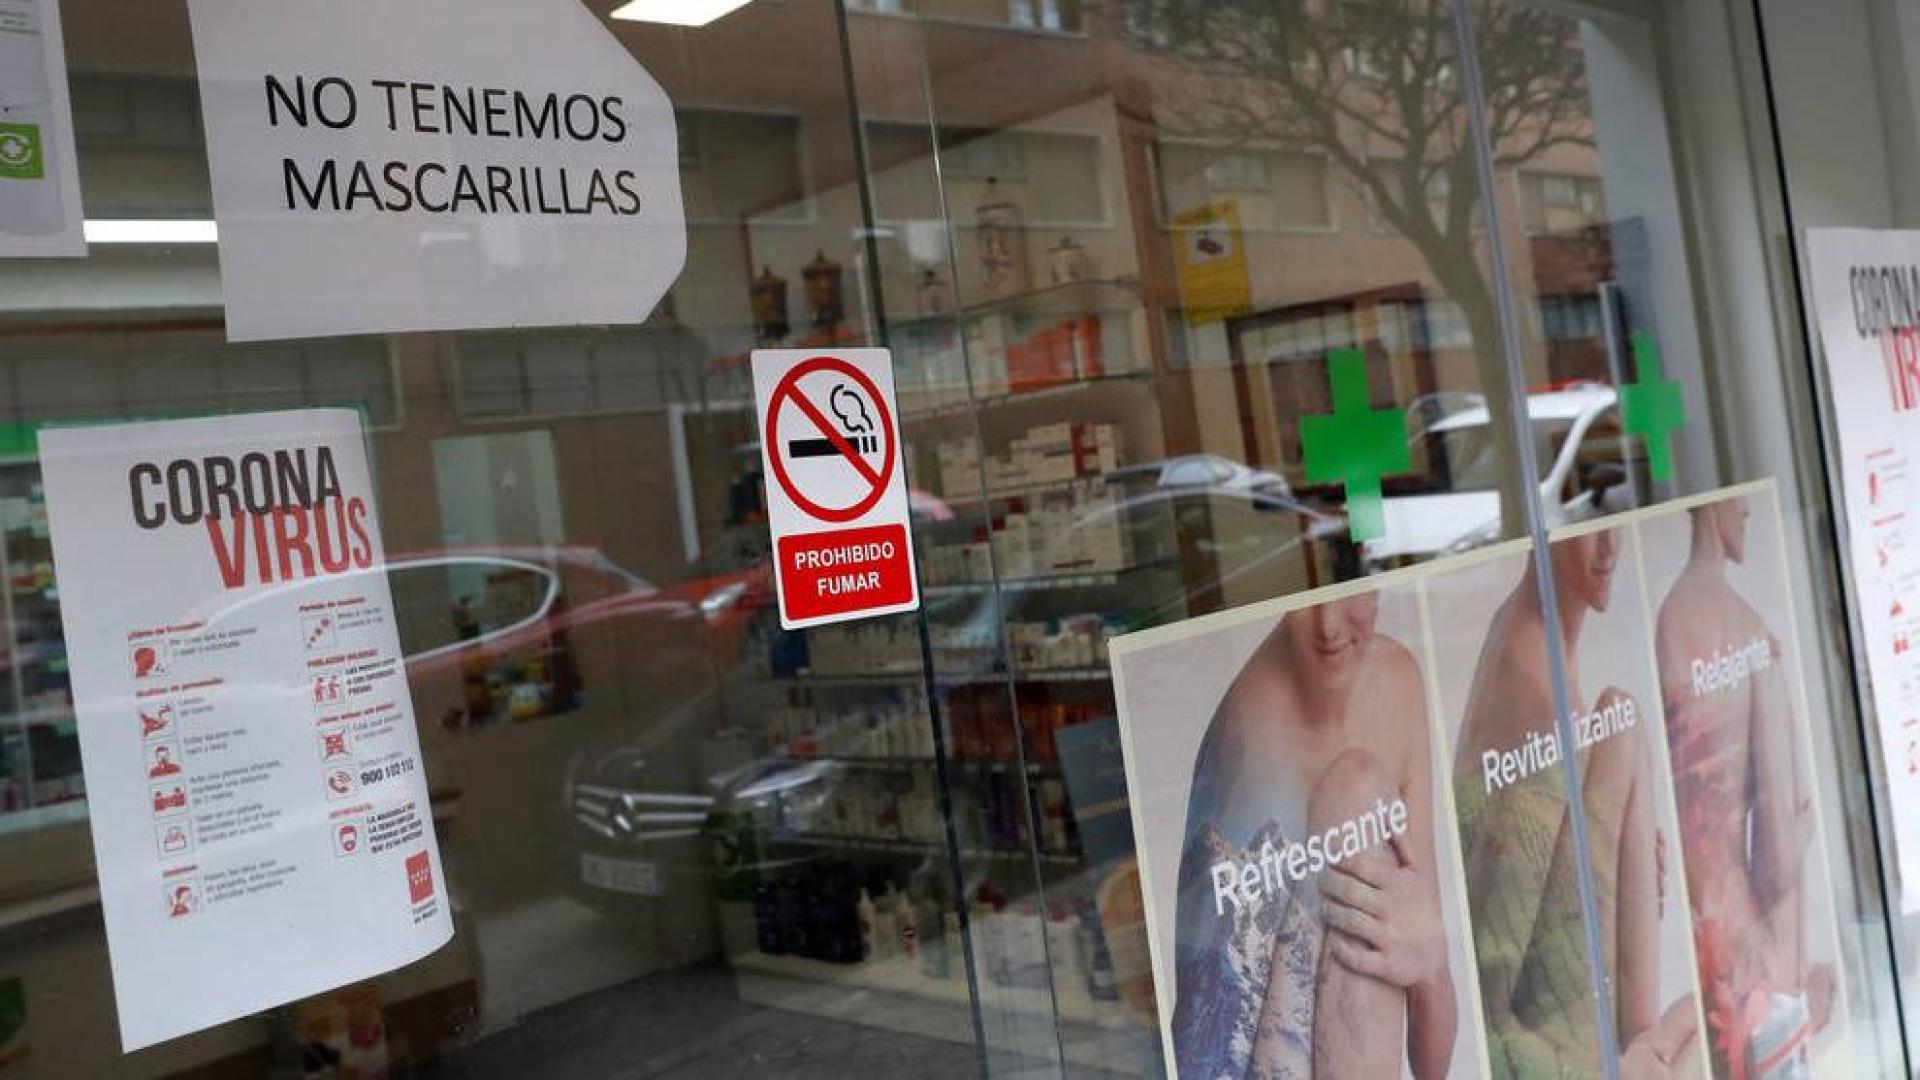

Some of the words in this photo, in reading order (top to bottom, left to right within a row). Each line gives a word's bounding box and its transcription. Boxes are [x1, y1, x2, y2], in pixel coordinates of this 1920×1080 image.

[264, 75, 357, 130] NO
[372, 80, 627, 143] TENEMOS
[281, 158, 641, 216] MASCARILLAS
[129, 446, 342, 530] CORONA
[205, 495, 374, 589] VIRUS
[795, 542, 894, 570] PROHIBIDO
[817, 571, 881, 596] FUMAR
[1690, 637, 1770, 698] Relajante
[360, 767, 384, 786] 900
[1482, 696, 1637, 795] Revitalizante
[1210, 797, 1408, 916] Refrescante
